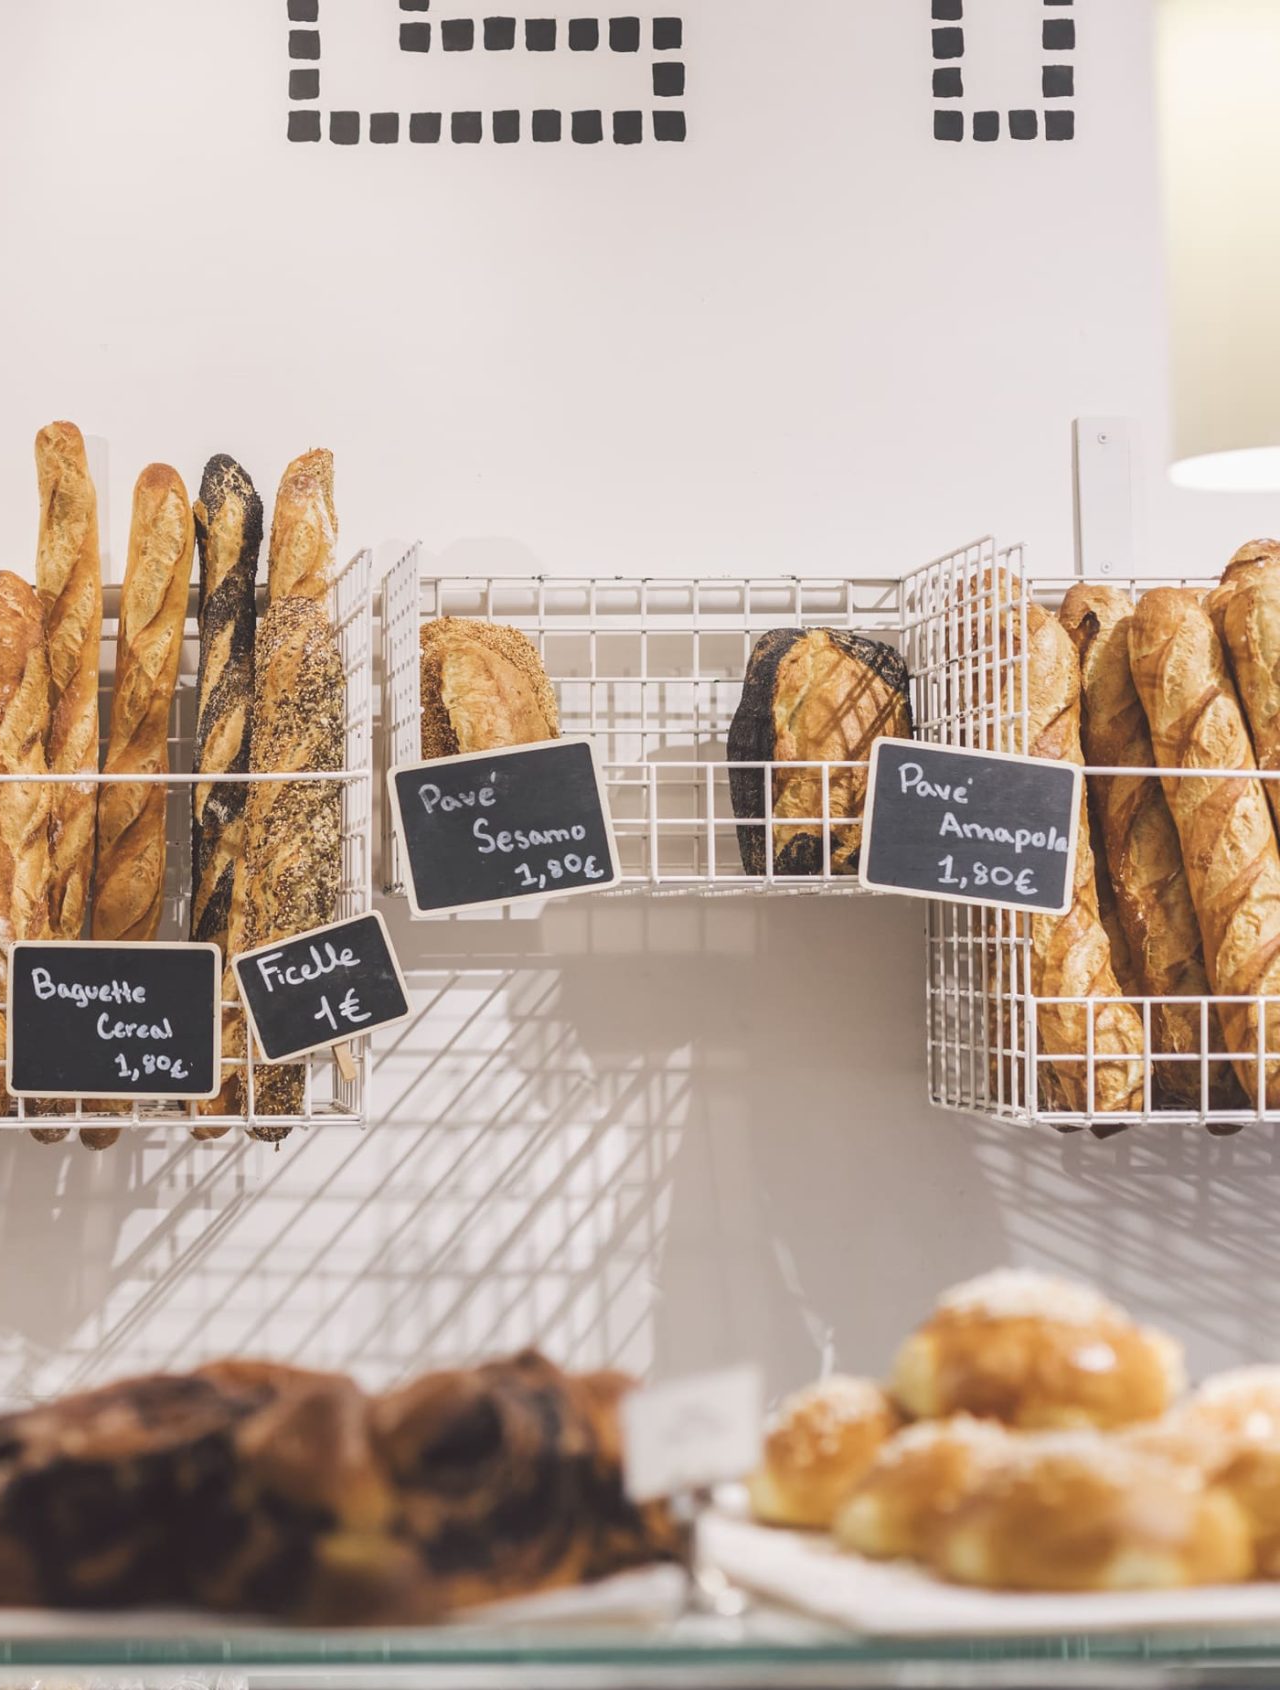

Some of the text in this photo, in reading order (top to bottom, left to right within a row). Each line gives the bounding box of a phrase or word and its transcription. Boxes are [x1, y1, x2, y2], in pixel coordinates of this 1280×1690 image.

[418, 771, 496, 814] Pavé
[898, 762, 973, 804] Pavé
[473, 817, 586, 853] Sesamo
[939, 811, 1069, 853] Amapola
[514, 853, 604, 889] 1,80€
[937, 854, 1038, 896] 1,80€
[31, 967, 146, 1008] Baguette
[256, 942, 361, 992] Ficelle
[97, 1012, 173, 1040] Cereal
[115, 1053, 189, 1082] 1,80€
